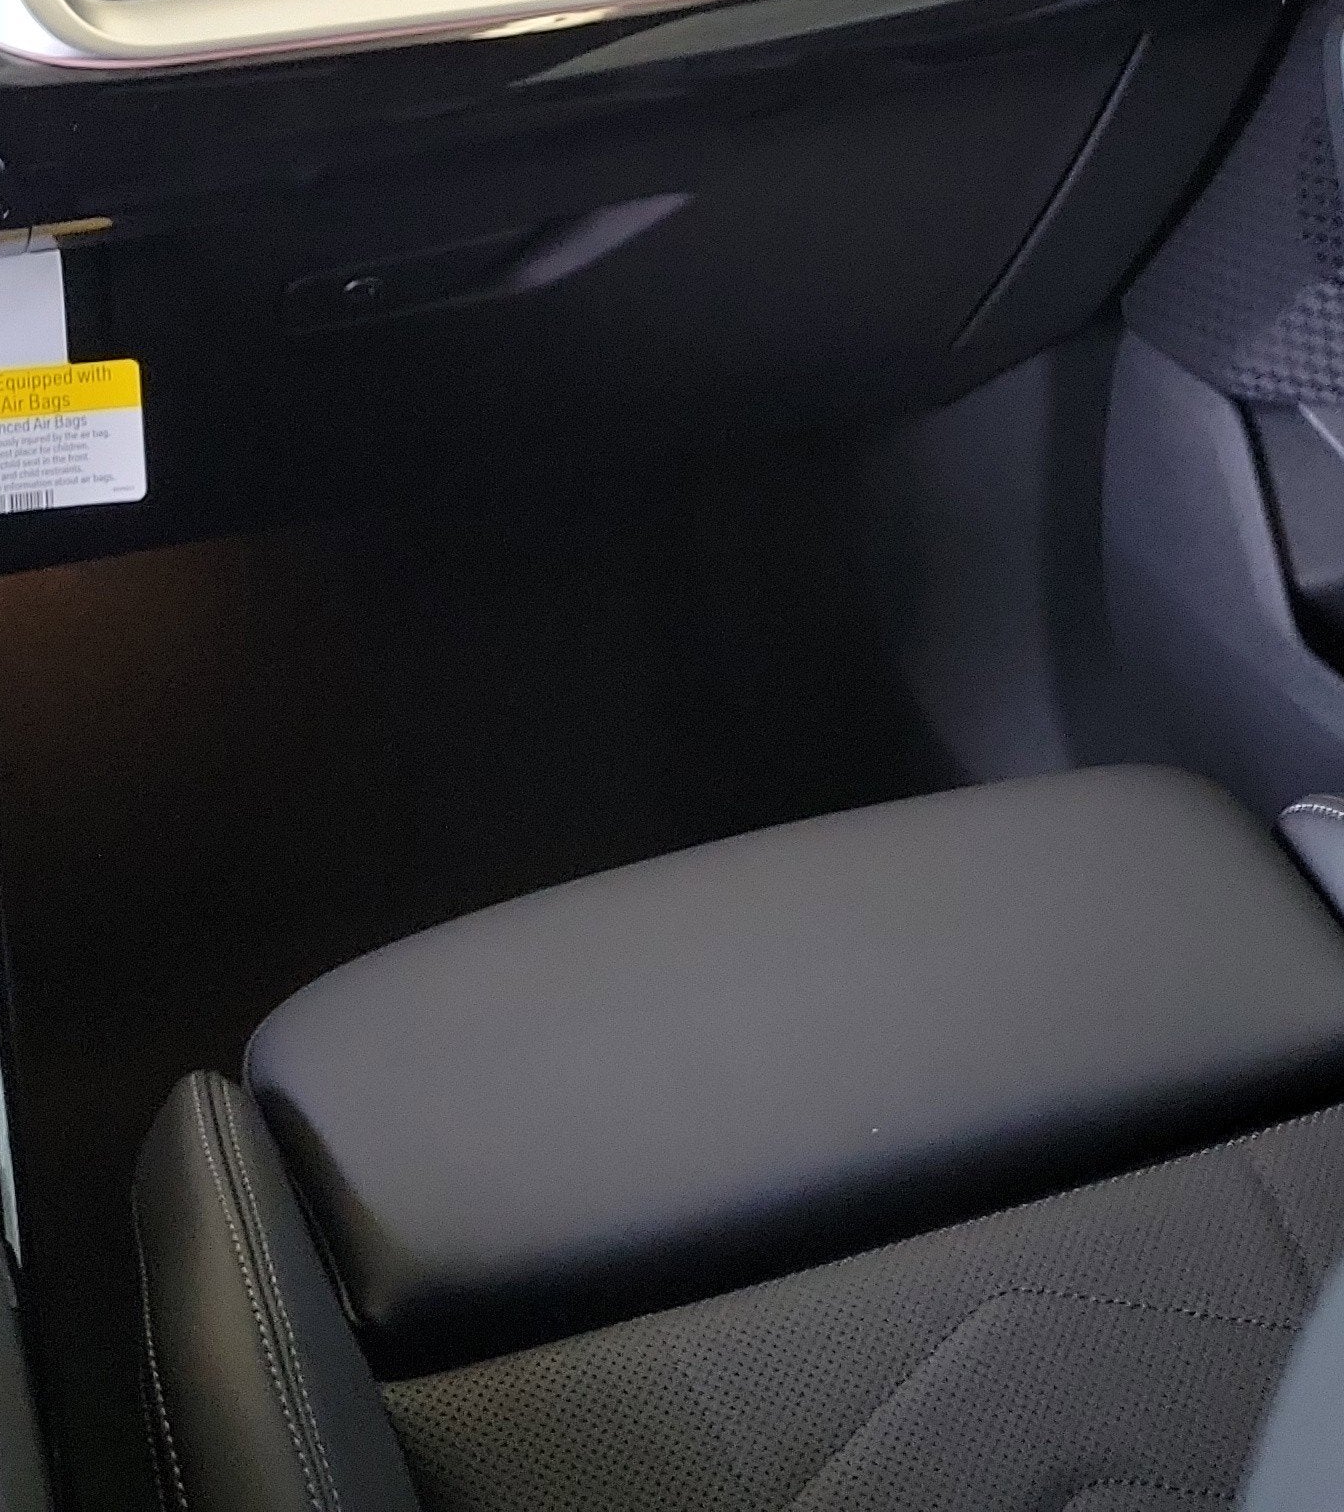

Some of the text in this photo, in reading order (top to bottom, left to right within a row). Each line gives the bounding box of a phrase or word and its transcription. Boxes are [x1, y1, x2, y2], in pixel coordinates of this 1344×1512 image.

[77, 365, 112, 383] with
[1, 395, 25, 413] Air
[29, 392, 70, 412] Bags
[33, 417, 50, 432] Air
[54, 414, 87, 431] Bags
